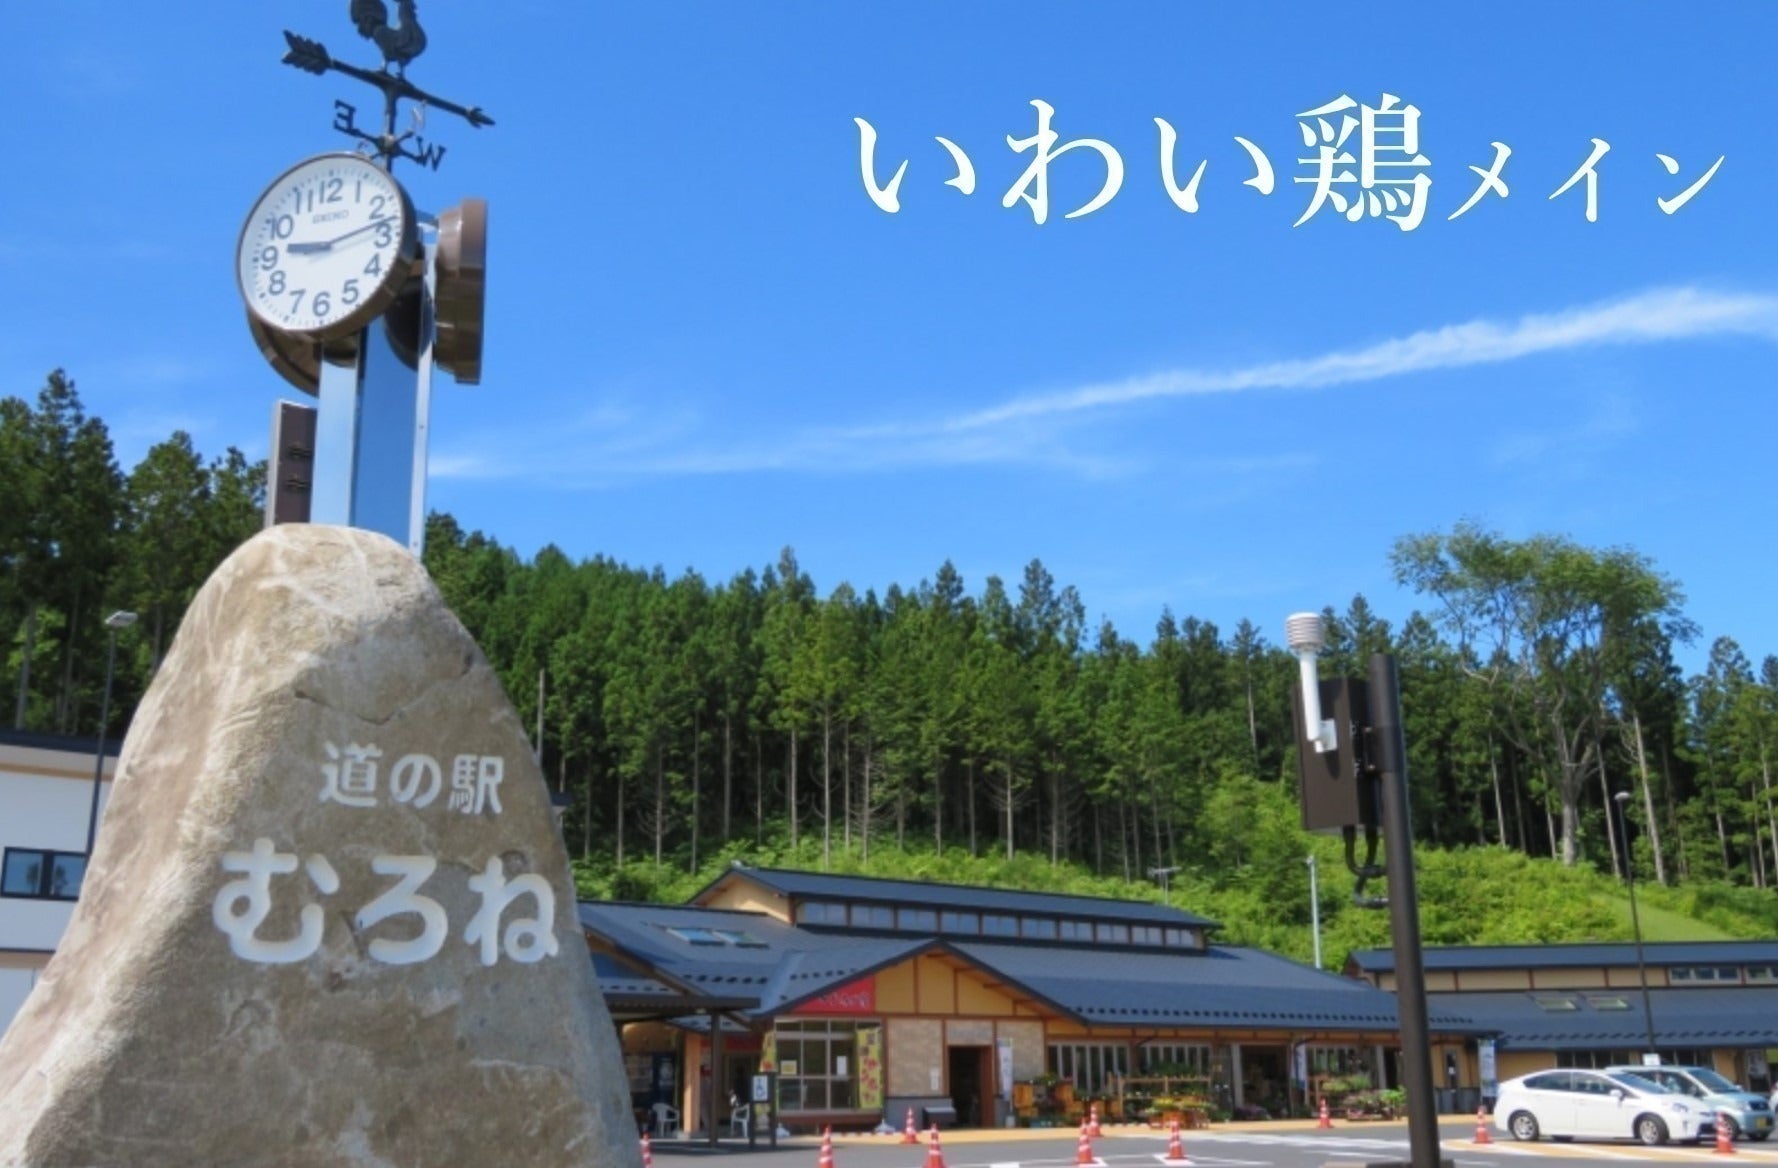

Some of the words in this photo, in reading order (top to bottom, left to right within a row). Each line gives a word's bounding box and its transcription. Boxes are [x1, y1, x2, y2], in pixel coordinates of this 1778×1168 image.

[417, 136, 447, 171] W
[296, 189, 313, 213] 11
[319, 178, 343, 204] 12
[355, 180, 361, 203] 1
[369, 196, 386, 220] 2
[271, 215, 294, 240] 10
[375, 222, 392, 248] 3
[261, 247, 279, 272] 9
[364, 254, 381, 277] 4
[269, 271, 286, 295] 8
[342, 279, 358, 305] 5
[290, 290, 306, 314] 7
[312, 292, 330, 316] 6
[318, 741, 505, 815] 道の駅
[213, 837, 559, 967] むろね
